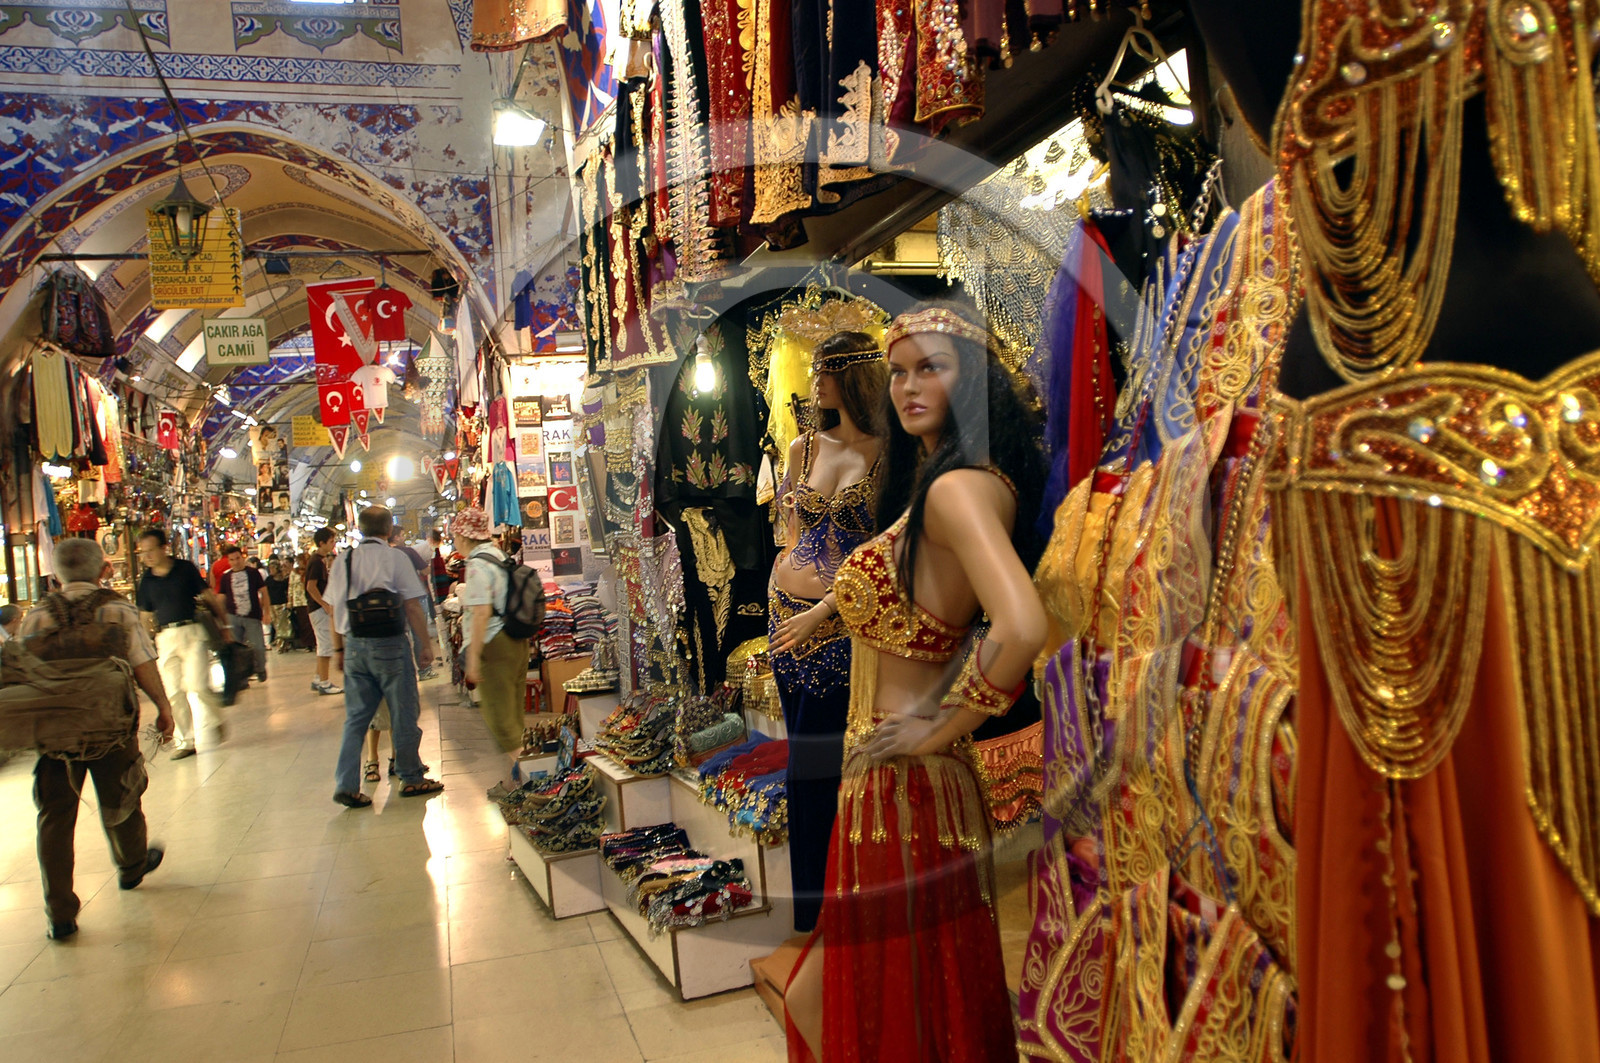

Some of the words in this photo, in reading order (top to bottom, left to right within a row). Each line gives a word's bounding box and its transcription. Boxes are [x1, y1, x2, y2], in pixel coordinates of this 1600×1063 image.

[153, 275, 196, 284] PERDAHÇILAR
[191, 286, 204, 294] EXIT
[155, 297, 234, 306] www.mygrandbazaar.net
[218, 340, 255, 357] CAMİİ
